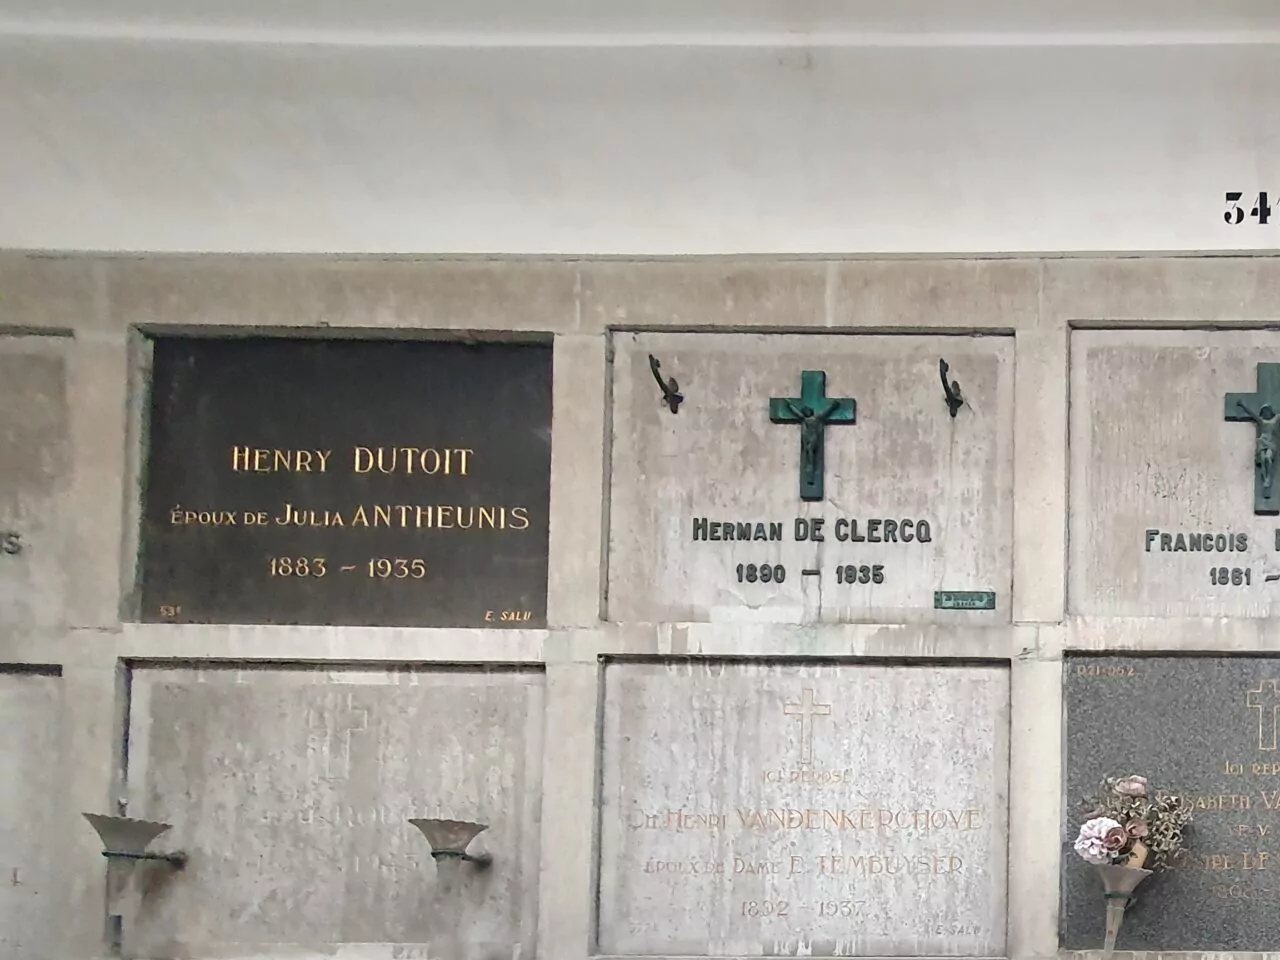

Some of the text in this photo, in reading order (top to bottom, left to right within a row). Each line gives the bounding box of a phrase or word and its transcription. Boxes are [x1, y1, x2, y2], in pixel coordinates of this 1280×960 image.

[232, 446, 475, 475] HENRY DUTOIT
[171, 504, 530, 530] ÉPOUX DE JULIA ANTHEUNIS
[693, 518, 932, 543] HERMAN DE CLERCQ
[1145, 529, 1248, 552] FRANCOIS
[270, 557, 426, 579] 1883 1935
[736, 564, 885, 584] 1890 1935
[1210, 567, 1251, 586] 1861
[1225, 761, 1243, 776] ICI
[667, 807, 726, 830] HENRI
[737, 808, 983, 831] VANDENKERCHOVE
[704, 861, 726, 875] DE
[734, 856, 783, 875] DAME
[741, 901, 789, 917] 1892
